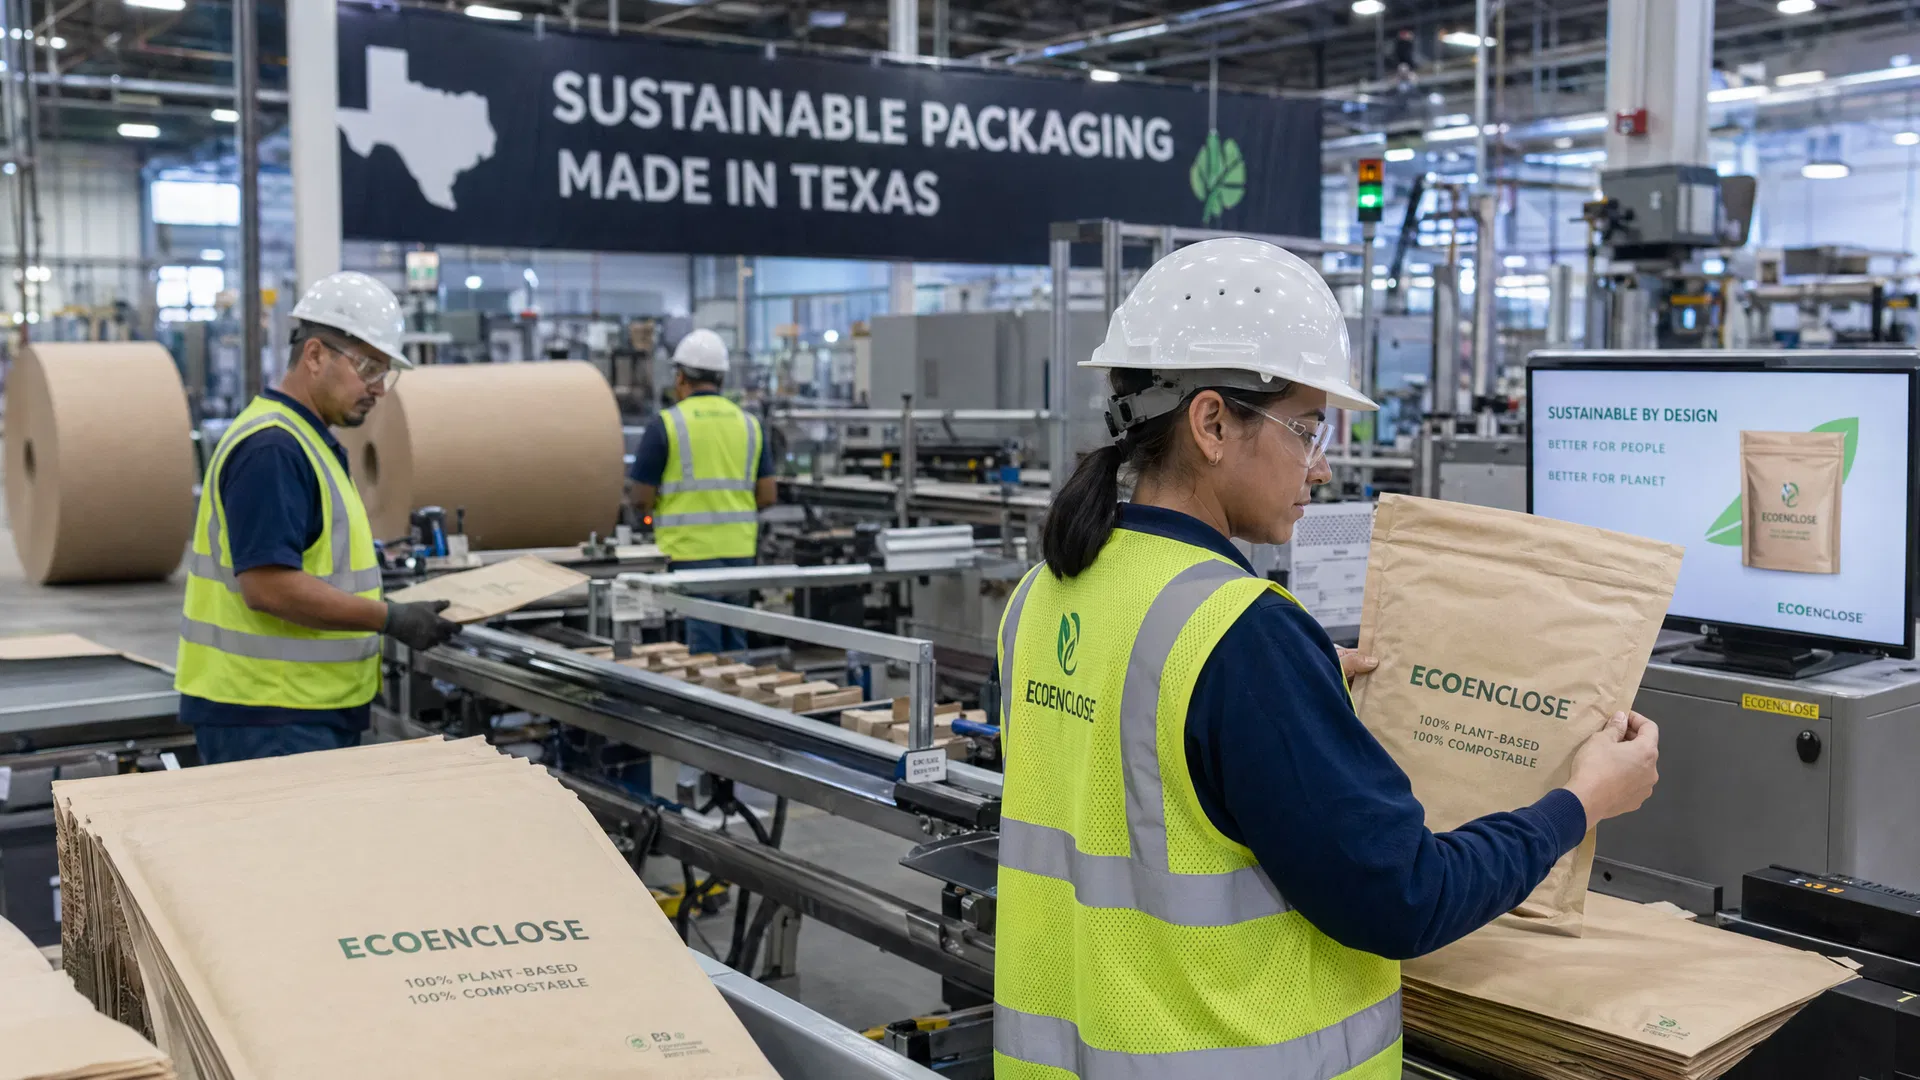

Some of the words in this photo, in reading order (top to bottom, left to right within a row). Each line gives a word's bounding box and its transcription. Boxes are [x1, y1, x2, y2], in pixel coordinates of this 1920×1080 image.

[552, 70, 907, 145] SUSTAINABLE
[921, 101, 1174, 162] PACKAGING
[558, 148, 712, 205] MADE
[726, 159, 778, 208] IN
[791, 162, 941, 217] TEXAS
[1548, 406, 1638, 421] SUSTAINABLE
[1642, 407, 1659, 421] BY
[1664, 408, 1718, 423] DESIGN
[1548, 439, 1588, 451] BETTER
[1592, 441, 1616, 452] FOR
[1621, 442, 1666, 454] PEOPLE
[1548, 470, 1588, 482] BETTER
[1592, 472, 1616, 484] FOR
[1620, 474, 1666, 487] PLANET
[1762, 511, 1817, 525] ECOENCLOSE
[1777, 602, 1863, 623] ECOENCLOSE
[1025, 679, 1096, 723] ECOENCLOSE
[1409, 664, 1572, 720] ECOENCLOSE
[1744, 696, 1817, 717] ECOENCLOSE
[1419, 714, 1450, 731] 100%
[1454, 723, 1540, 751] PLANT-BASED
[1412, 730, 1444, 746] 100%
[1448, 738, 1538, 769] COMPOSTABLE
[337, 919, 590, 960] ECOENCLOSE
[404, 974, 453, 989] 100%
[457, 963, 578, 984] PLANT-BASED
[407, 990, 457, 1005] 100%
[463, 977, 589, 1000] COMPOSTABLE
